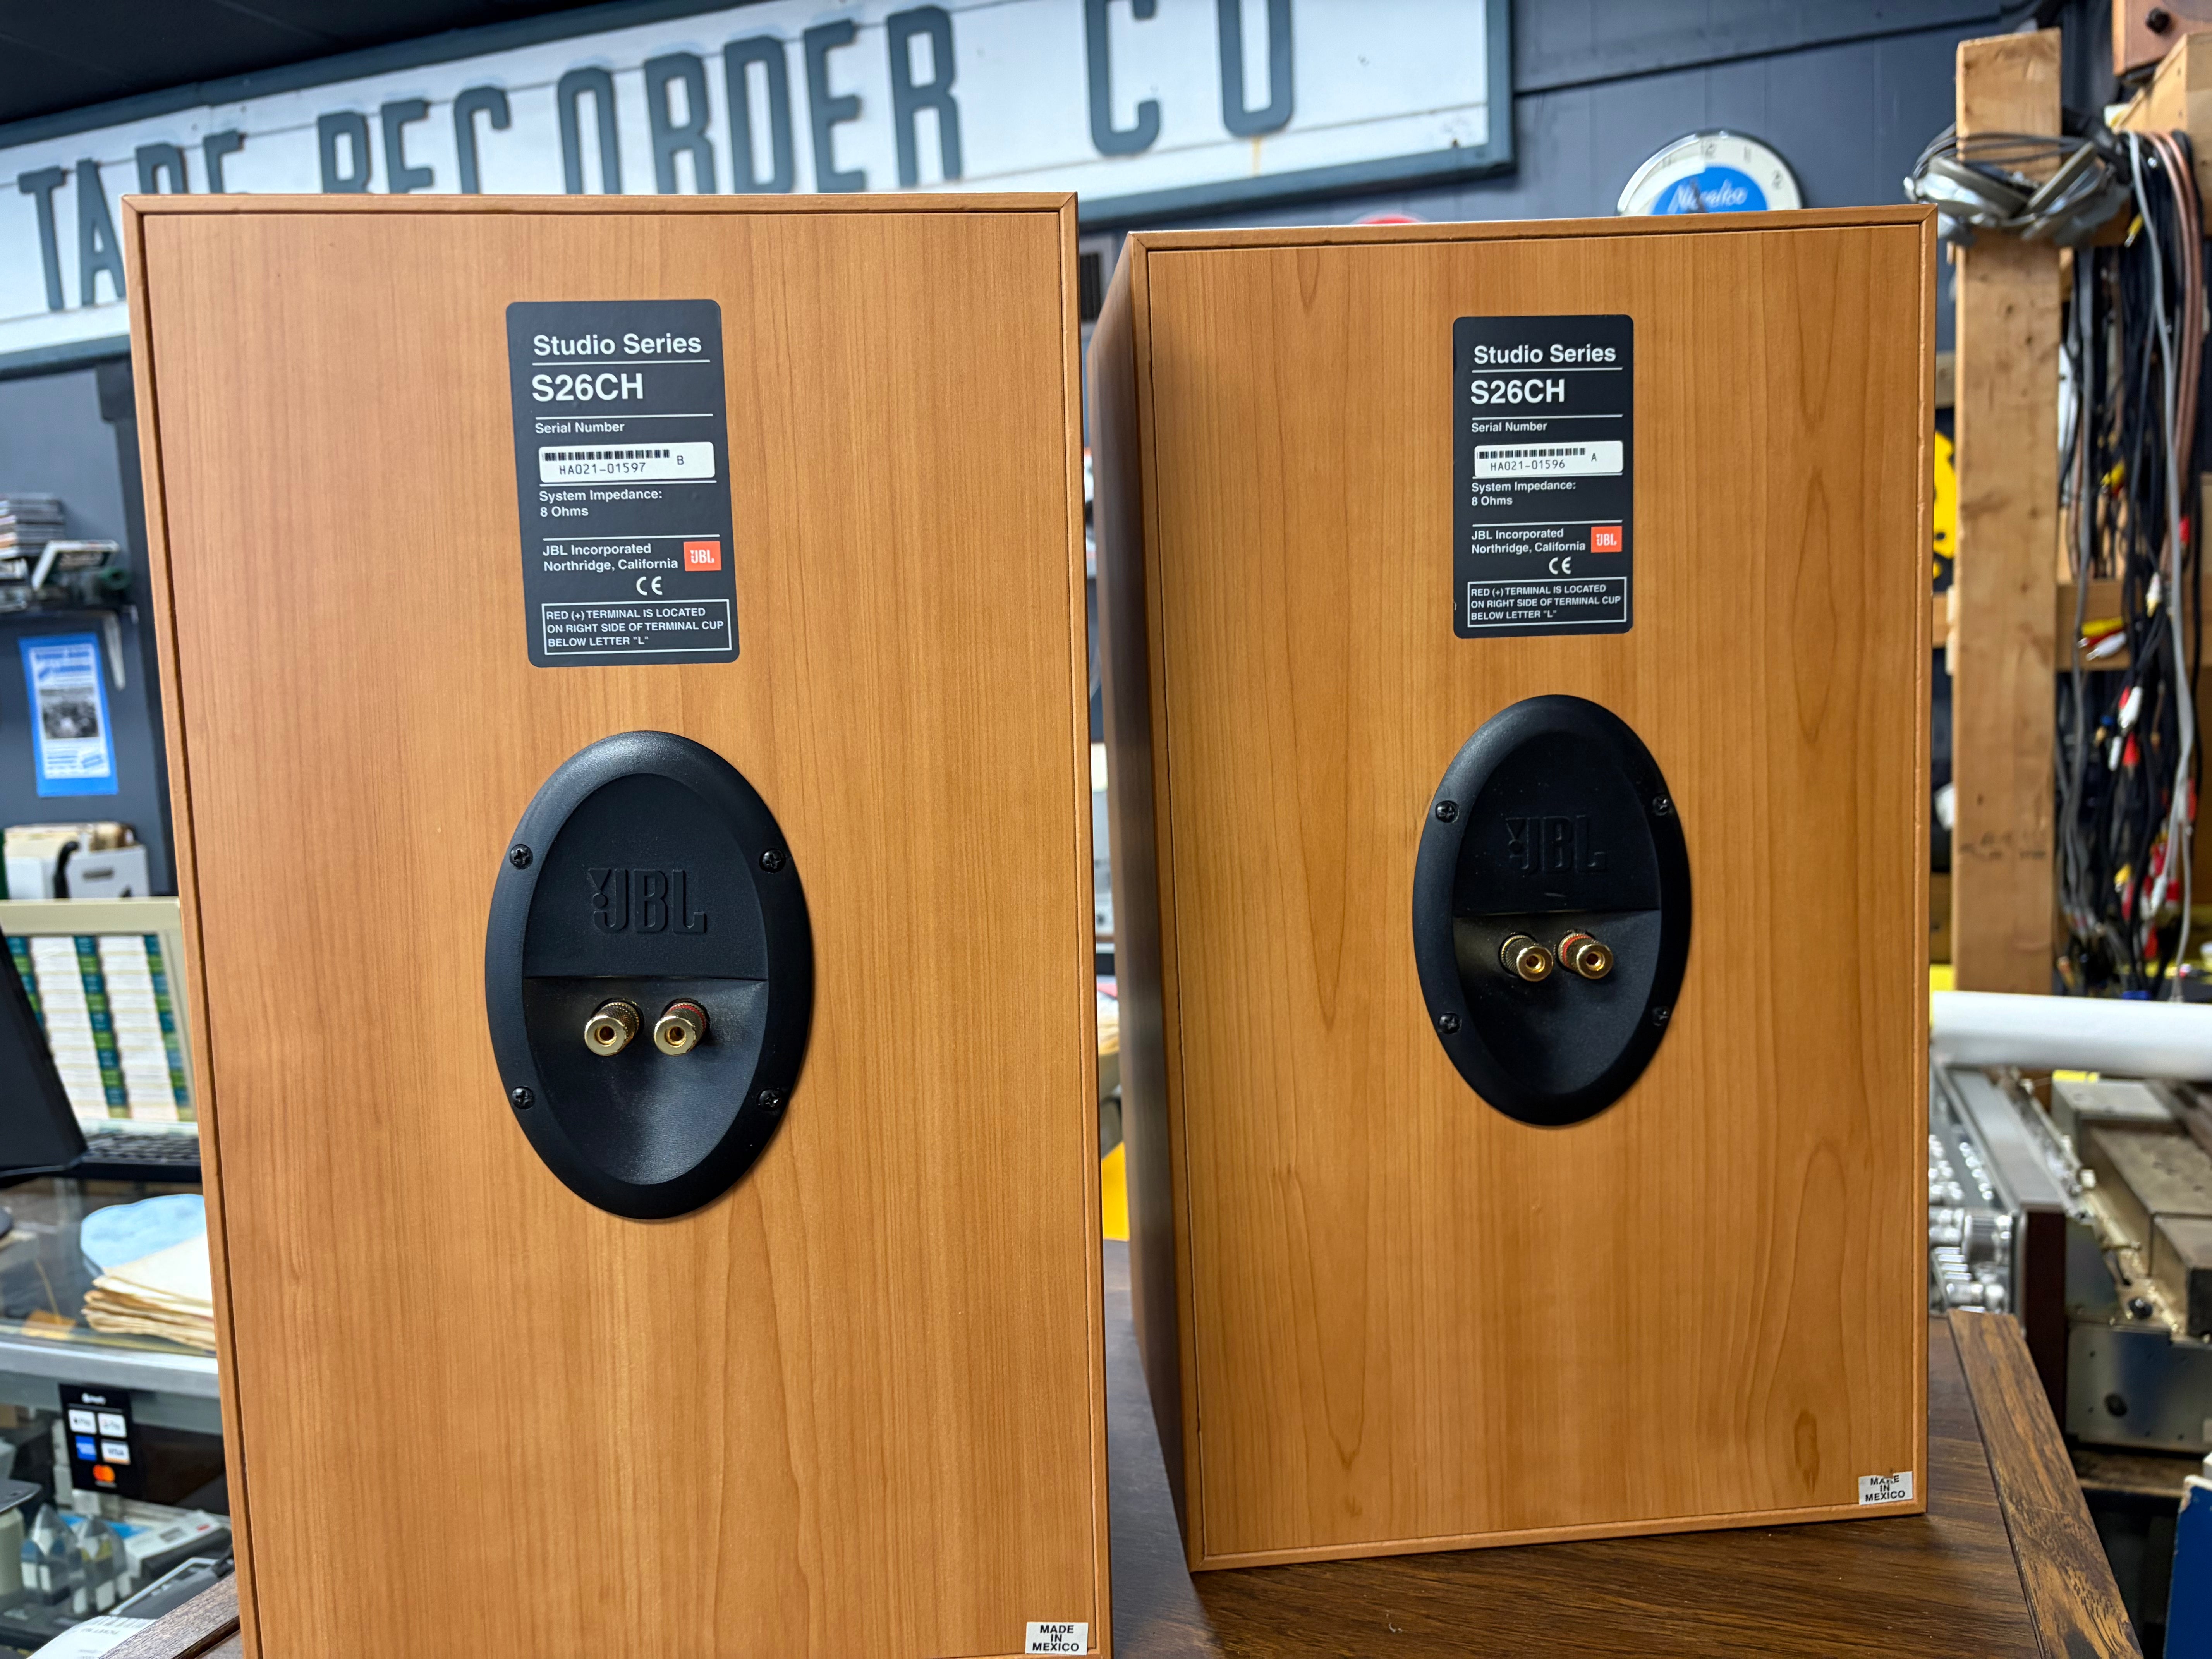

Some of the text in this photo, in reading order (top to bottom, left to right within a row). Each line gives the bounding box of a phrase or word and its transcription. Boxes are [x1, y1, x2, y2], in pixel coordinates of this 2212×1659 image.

[534, 333, 702, 356] Studio Series
[1474, 343, 1616, 364] Studio Series
[532, 373, 643, 402] S26CH
[1470, 379, 1565, 404] S26CH
[535, 421, 625, 434] Serial Number
[1471, 421, 1547, 433] Serial Number
[677, 455, 684, 465] B
[1591, 453, 1597, 462] A
[559, 462, 646, 475] HA021-01597
[1491, 459, 1565, 471] HA021-01596
[1472, 481, 1576, 494] System Impedance:
[539, 489, 662, 503] System Impedance:
[1471, 496, 1513, 506] 8 Ohms
[540, 506, 589, 517] 8 Ohms
[1471, 528, 1564, 541] JBL Incorporated
[1596, 533, 1617, 546] JBL
[543, 543, 651, 557] JBL Incorporated
[1472, 541, 1585, 555] Northridge, California
[690, 550, 714, 563] JBL
[544, 558, 678, 573] Northridge, California
[1549, 556, 1571, 575] CE
[636, 576, 663, 596] CE
[1471, 584, 1606, 598] RED (+) TERMINAL IS LOCATED
[1471, 596, 1621, 608] ON RIGHT SIDE OF TERMINAL CUP
[546, 608, 706, 621] RED (+) TERMINAL IS LOCATED
[1471, 611, 1504, 620] BELOW
[1506, 610, 1540, 619] LETTER
[547, 621, 724, 634] ON RIGHT SIDE OF TERMINAL CUP
[548, 637, 586, 647] BELOW
[589, 636, 630, 646] LETTER
[1506, 816, 1607, 873] JBL
[588, 869, 707, 933] JBL
[1865, 1490, 1905, 1502] MEXICO
[1040, 1625, 1074, 1633] MADE
[1051, 1634, 1062, 1642] IN
[1032, 1642, 1079, 1652] MEXICO
